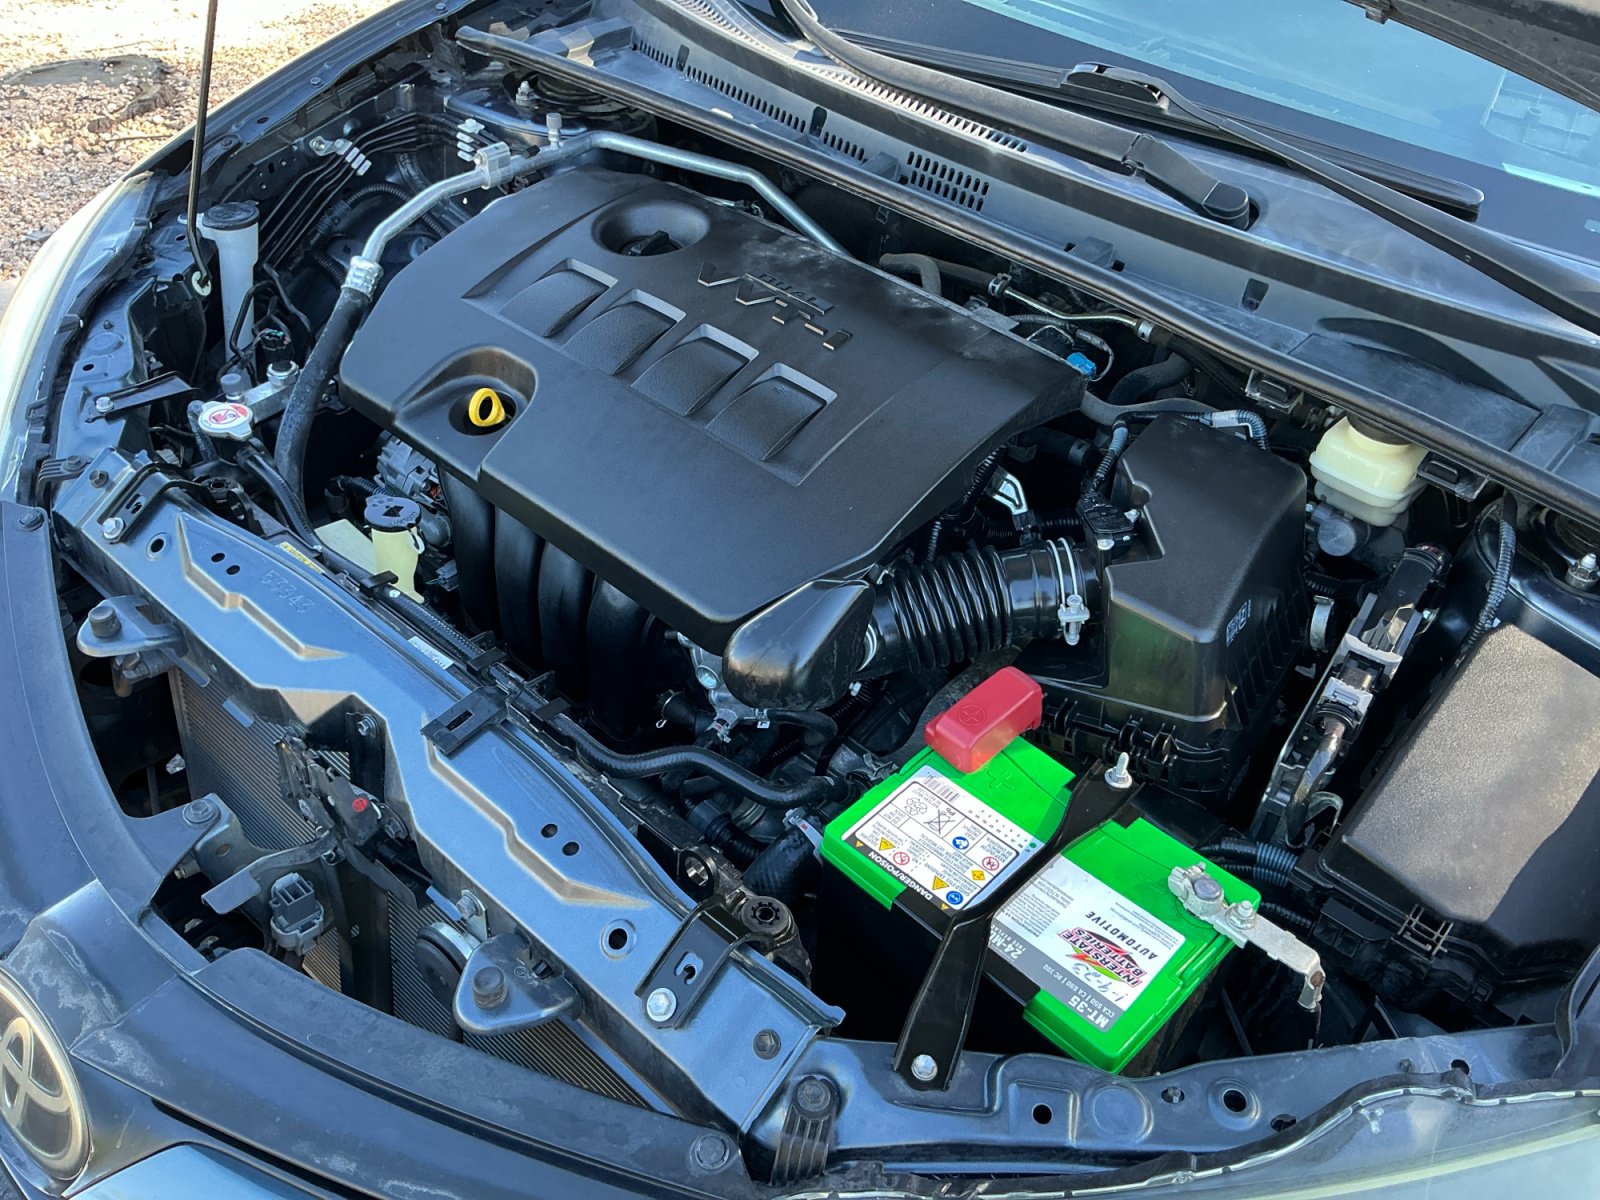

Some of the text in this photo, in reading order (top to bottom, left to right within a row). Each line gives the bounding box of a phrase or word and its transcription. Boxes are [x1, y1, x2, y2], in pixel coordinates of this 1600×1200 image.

[944, 807, 956, 816] Pb
[868, 851, 933, 901] DANGER/POISON
[1084, 909, 1158, 962] AUTOMOTIVE
[1061, 929, 1139, 987] INTERSTATE
[1073, 926, 1143, 977] BATTERIES
[1042, 963, 1055, 974] 100
[1052, 971, 1063, 980] RC
[1076, 988, 1087, 997] CA
[1089, 997, 1103, 1009] 550
[1067, 993, 1110, 1029] MT-35
[1101, 1005, 1115, 1018] CCA
